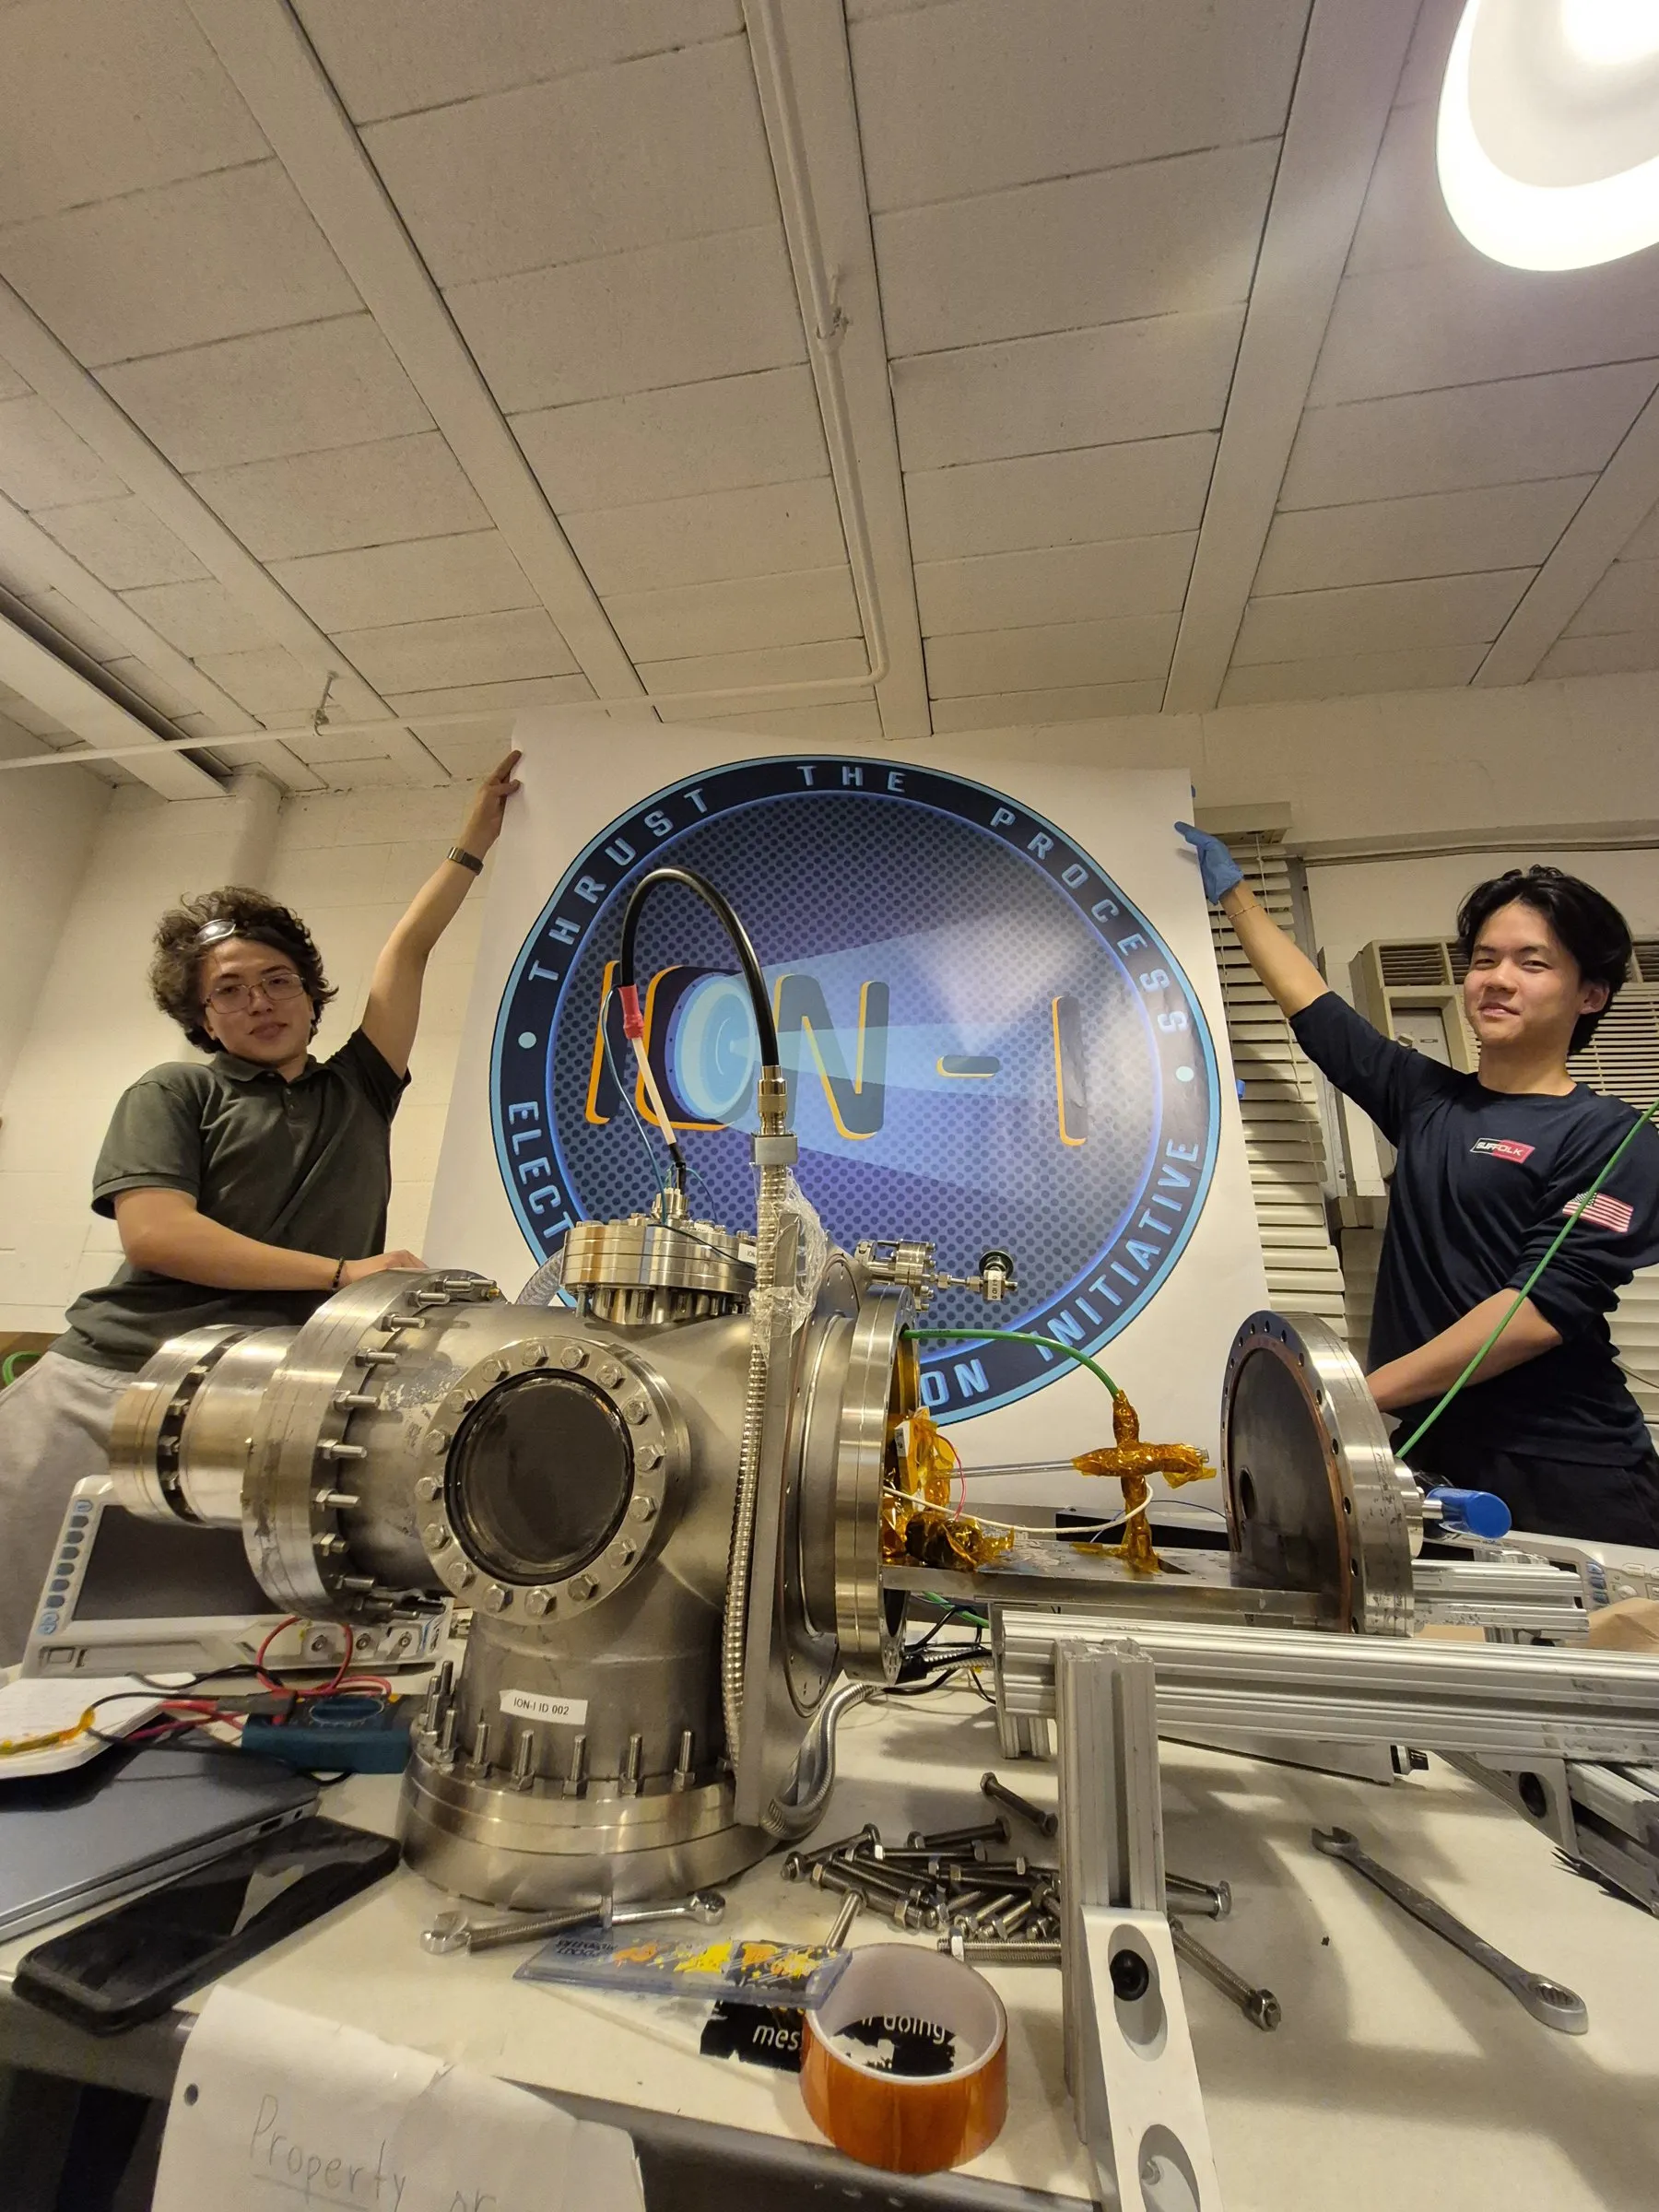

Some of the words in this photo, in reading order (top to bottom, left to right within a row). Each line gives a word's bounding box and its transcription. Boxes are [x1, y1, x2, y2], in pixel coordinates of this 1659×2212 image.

[528, 788, 708, 981] THRUST
[796, 765, 907, 793] THE
[990, 806, 1189, 1033] PROCESS
[1475, 1141, 1524, 1157] SUFFOLK
[509, 1101, 575, 1239] ELECT
[920, 1358, 990, 1406] ON
[1030, 1138, 1199, 1361] INITIATIVE
[538, 1703, 549, 1713] ID
[551, 1705, 570, 1715] 002
[752, 2025, 801, 2052] mes
[883, 2013, 946, 2044] doing
[250, 2093, 406, 2212] Property
